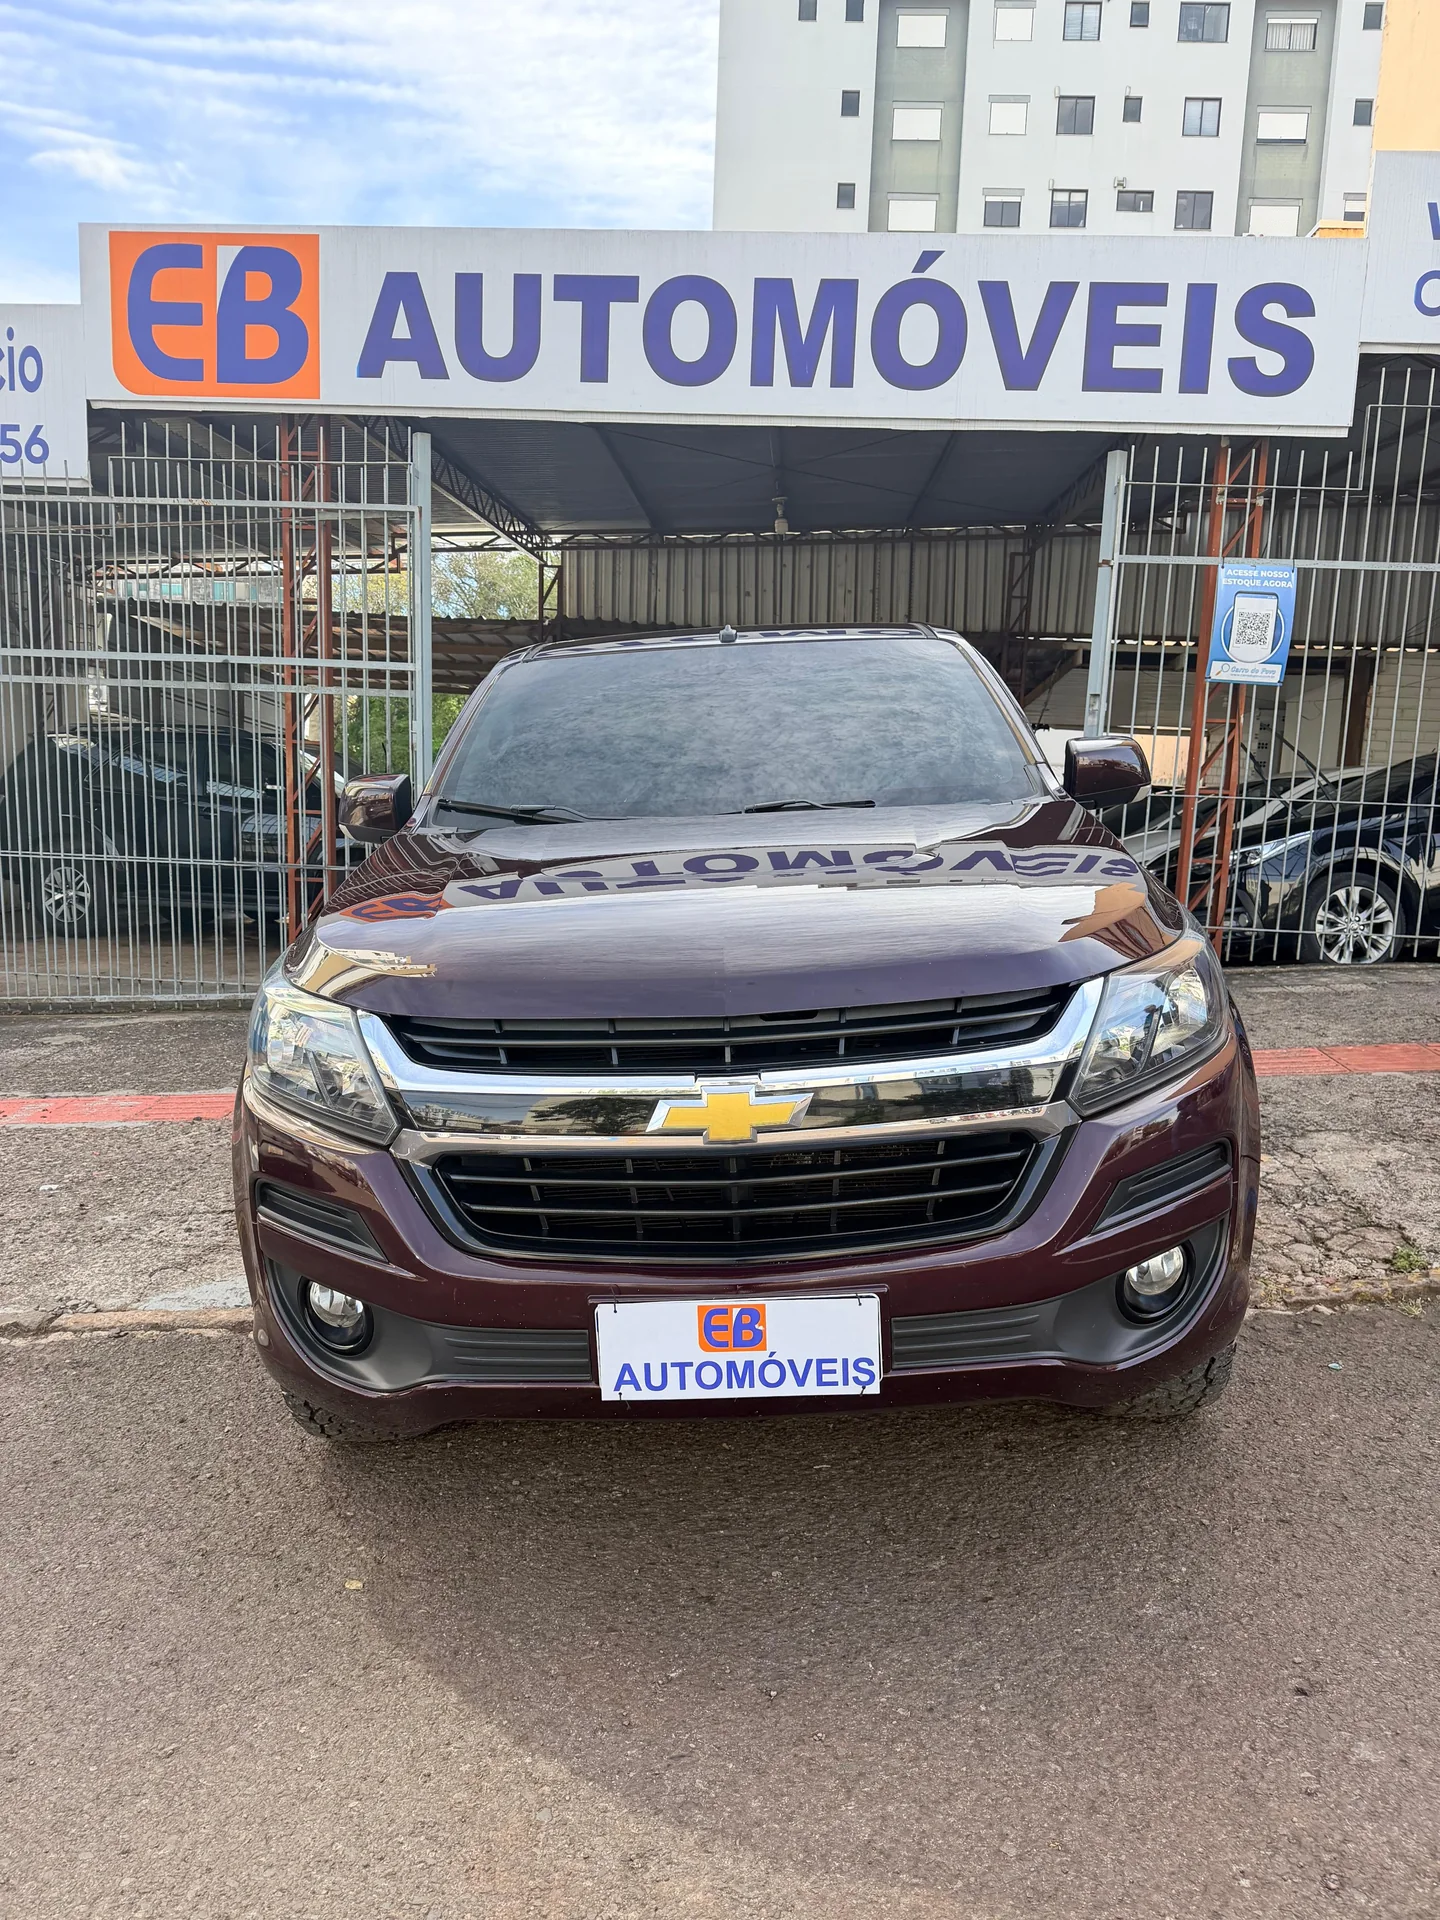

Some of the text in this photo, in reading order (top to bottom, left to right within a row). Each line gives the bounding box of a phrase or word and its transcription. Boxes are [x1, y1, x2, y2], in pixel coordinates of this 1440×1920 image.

[127, 243, 1316, 397] EB AUTOMÓVEIS
[0, 327, 44, 393] io
[1222, 578, 1293, 589] ESTOQUE AGORA
[1226, 569, 1290, 579] ACESSE NOSSO
[702, 1307, 764, 1348] EB
[613, 1351, 876, 1392] AUTOMÓVEIS
